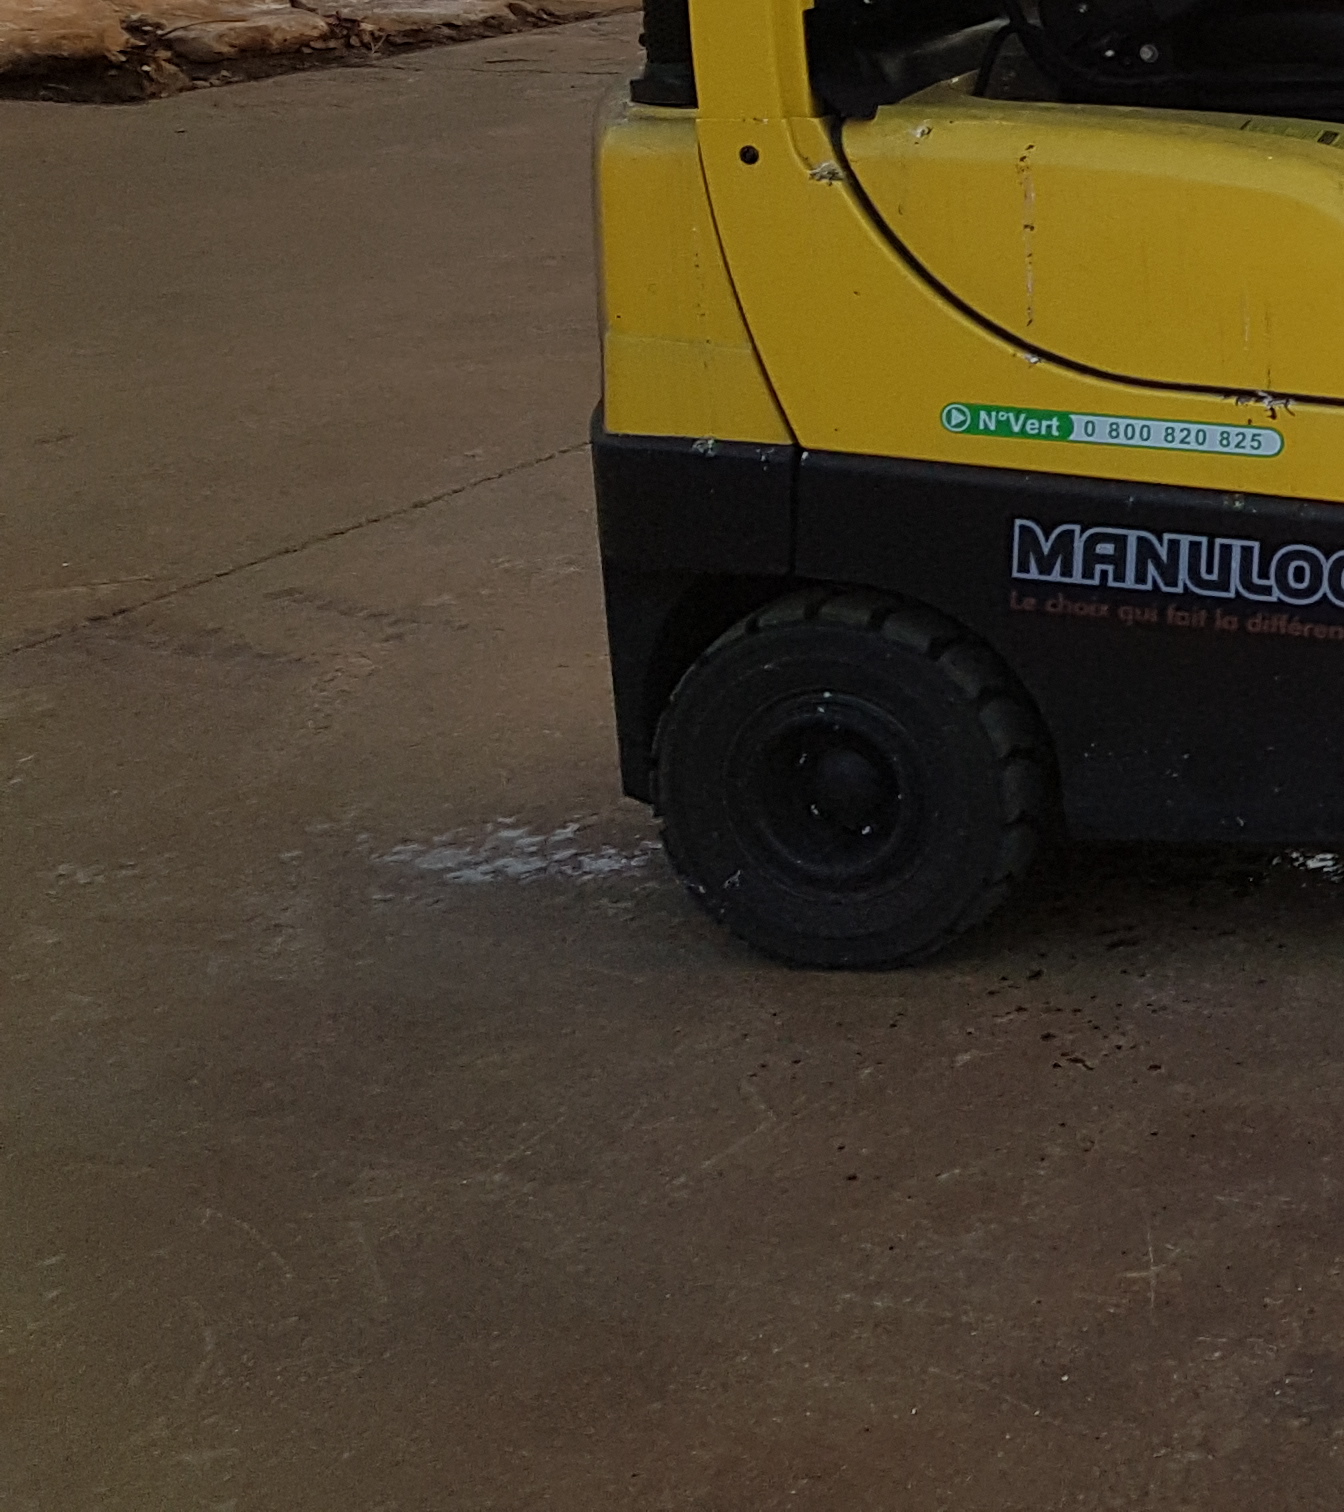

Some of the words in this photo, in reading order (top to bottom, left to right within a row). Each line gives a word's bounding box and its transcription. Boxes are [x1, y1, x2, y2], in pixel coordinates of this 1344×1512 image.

[1083, 420, 1096, 437] 0
[1107, 422, 1151, 442] 800
[1163, 426, 1207, 446] 820
[1219, 431, 1262, 450] 825
[1215, 609, 1238, 631] la
